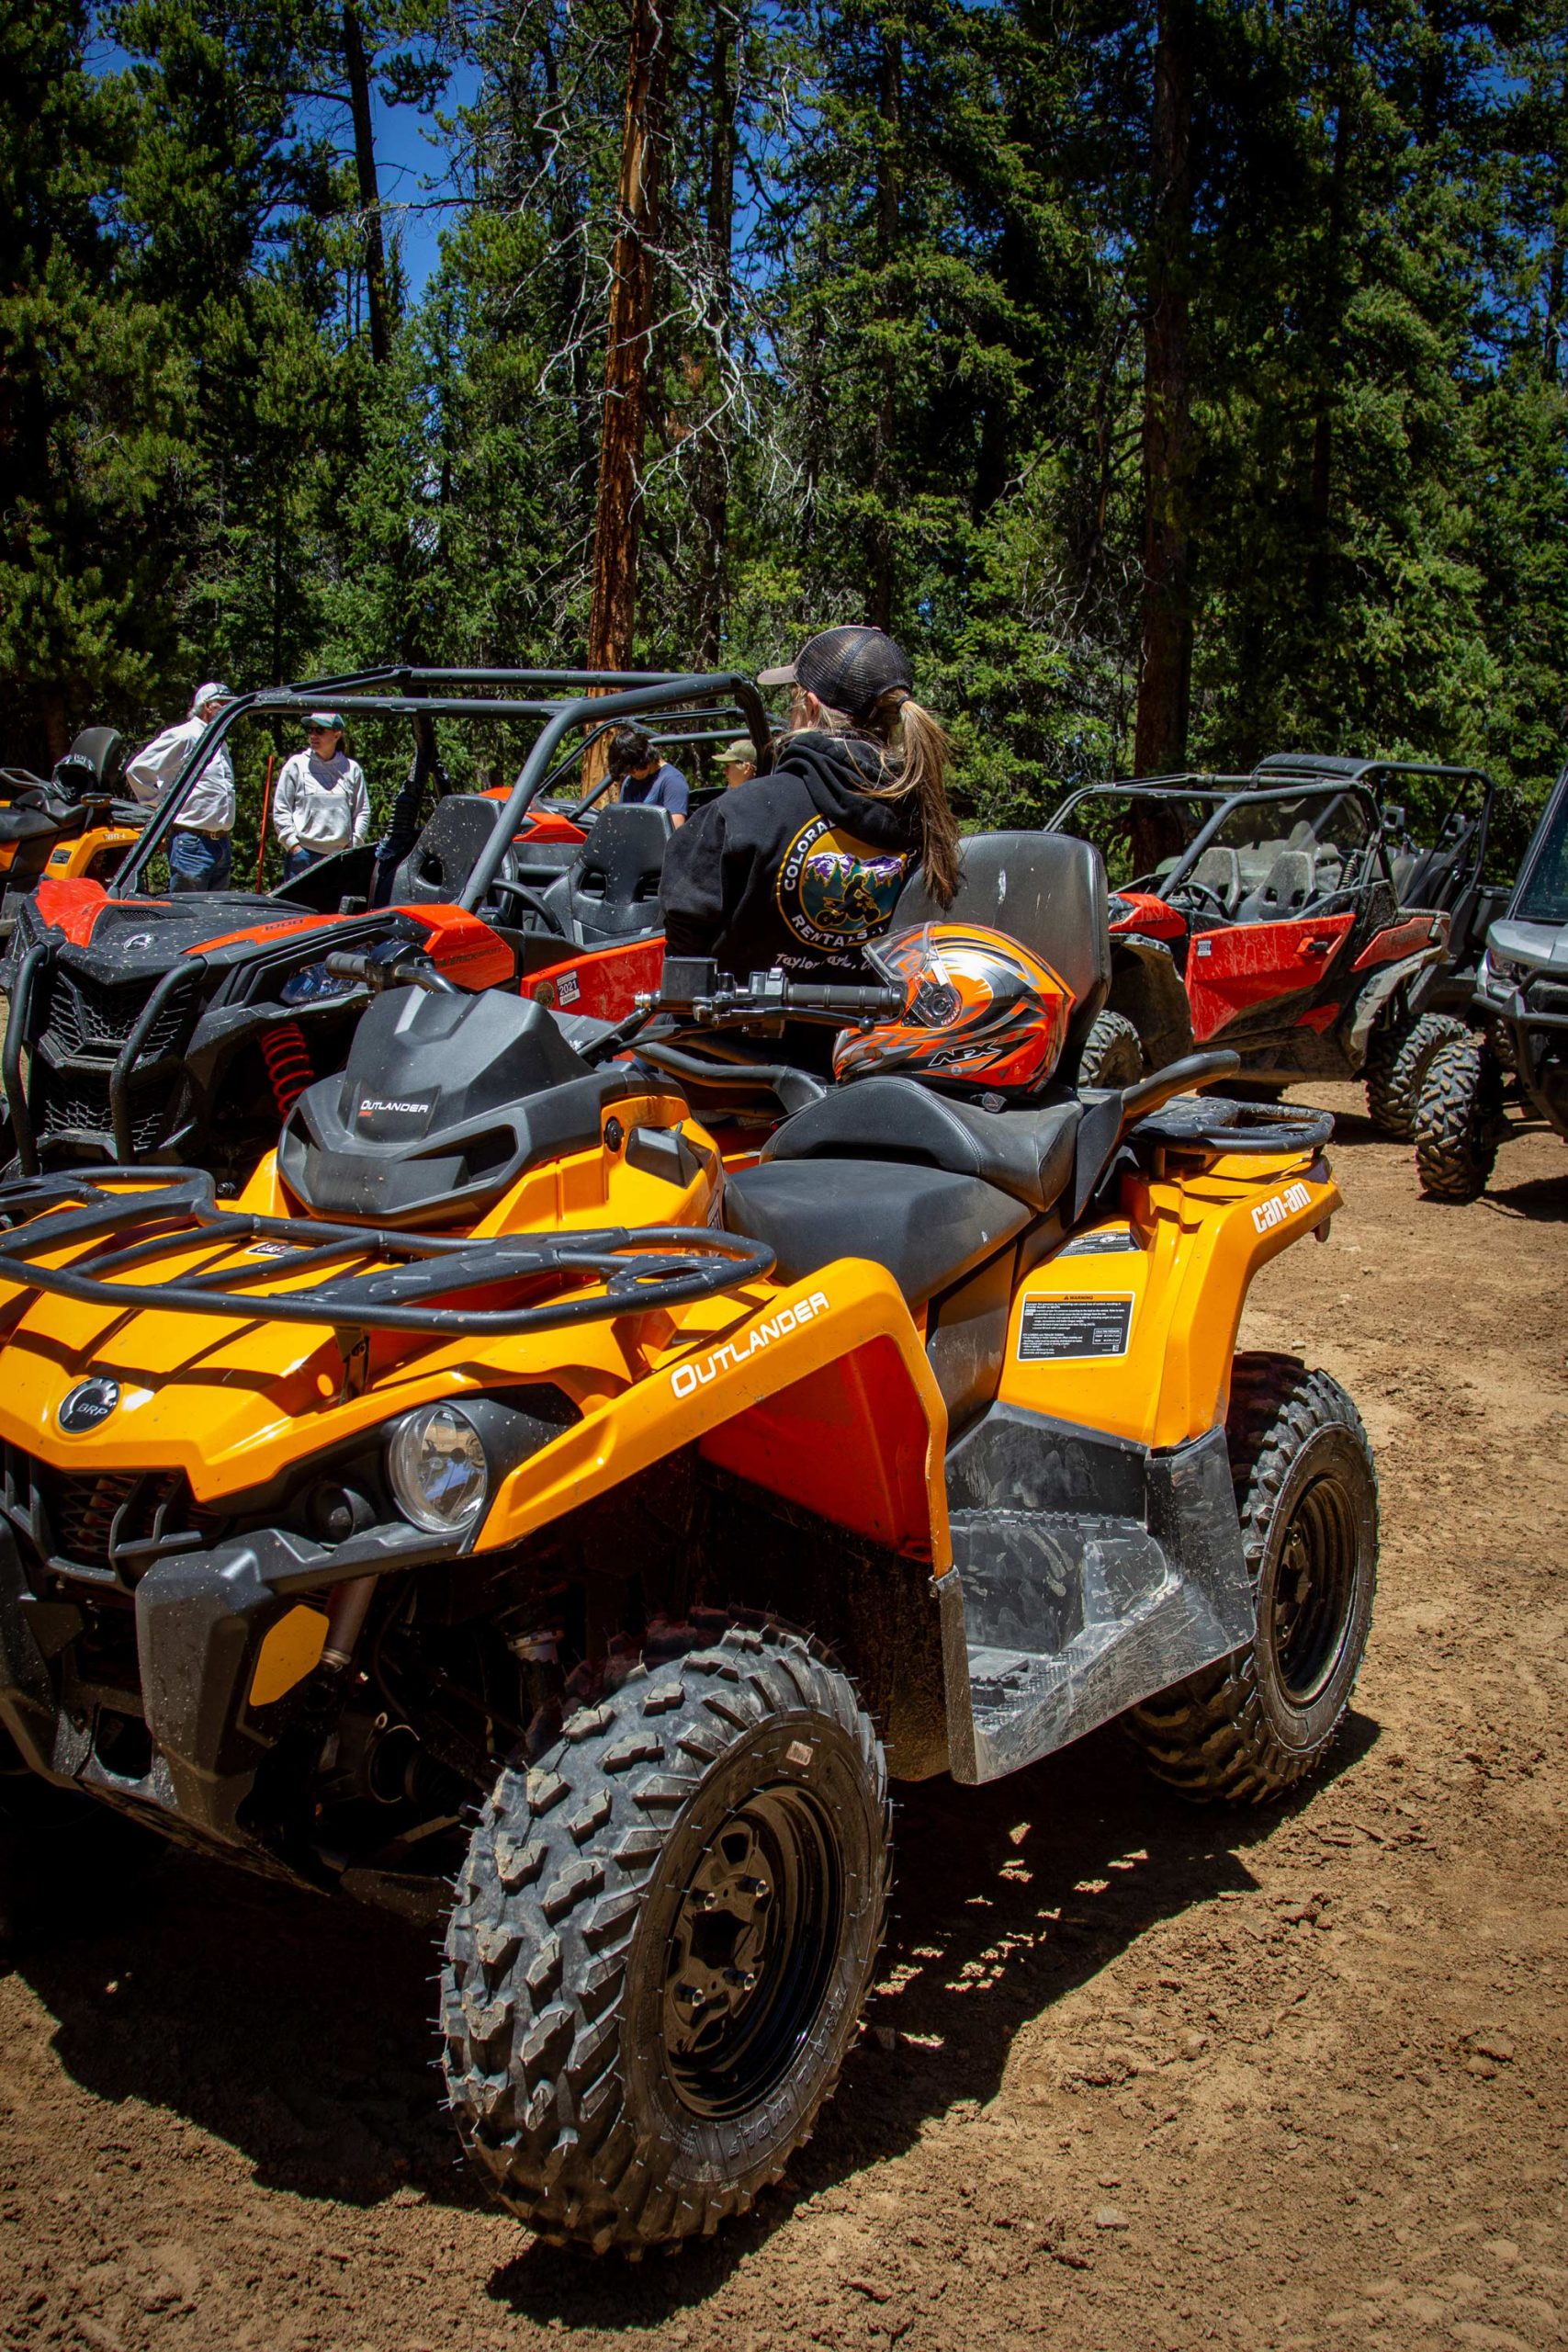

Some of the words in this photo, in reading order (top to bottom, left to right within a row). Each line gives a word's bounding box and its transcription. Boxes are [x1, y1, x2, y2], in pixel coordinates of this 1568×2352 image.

[774, 953, 821, 969] Taylor
[822, 955, 857, 970] ark,
[558, 979, 577, 996] 2021
[928, 1039, 1003, 1067] AFX
[360, 1100, 429, 1113] OUTLANDER
[1251, 1182, 1312, 1234] can-am
[671, 1291, 829, 1399] OUTLANDER
[76, 1403, 108, 1416] BRP
